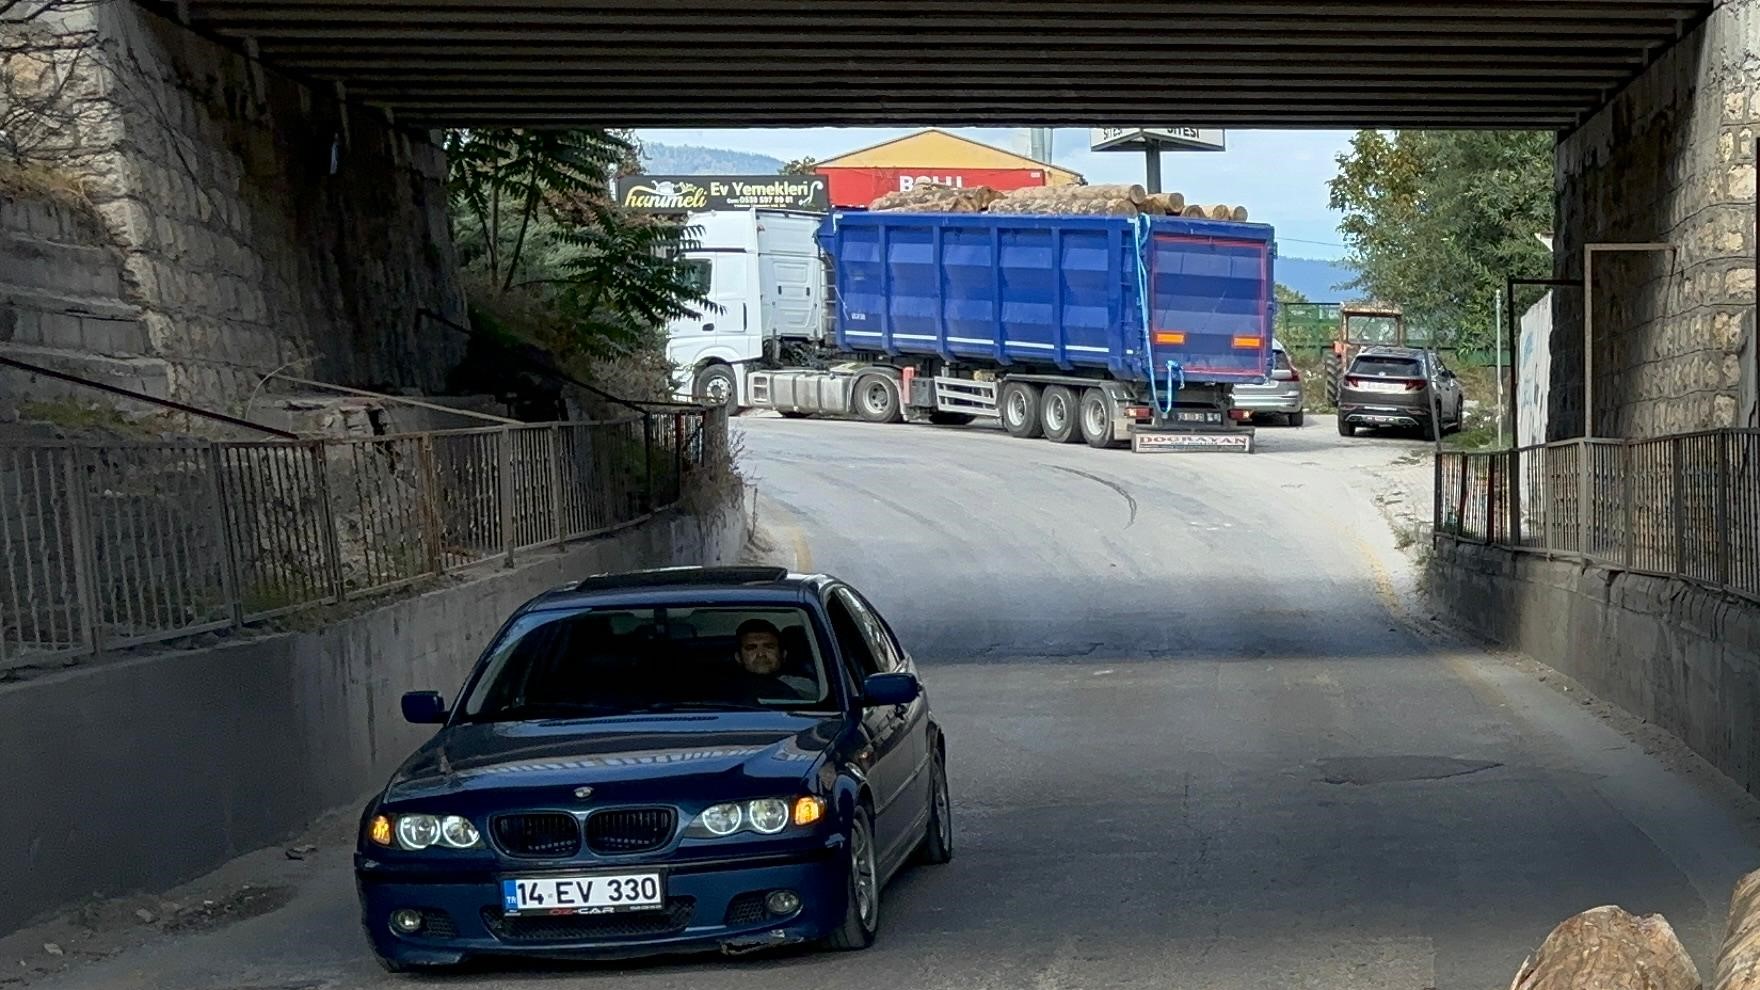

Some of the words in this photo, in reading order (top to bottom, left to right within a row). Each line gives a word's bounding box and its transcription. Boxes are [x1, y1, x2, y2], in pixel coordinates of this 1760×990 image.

[711, 182, 729, 196] Ev
[732, 181, 808, 196] Yemekleri
[517, 882, 544, 905] 14
[555, 881, 593, 904] EV
[607, 877, 657, 901] 330
